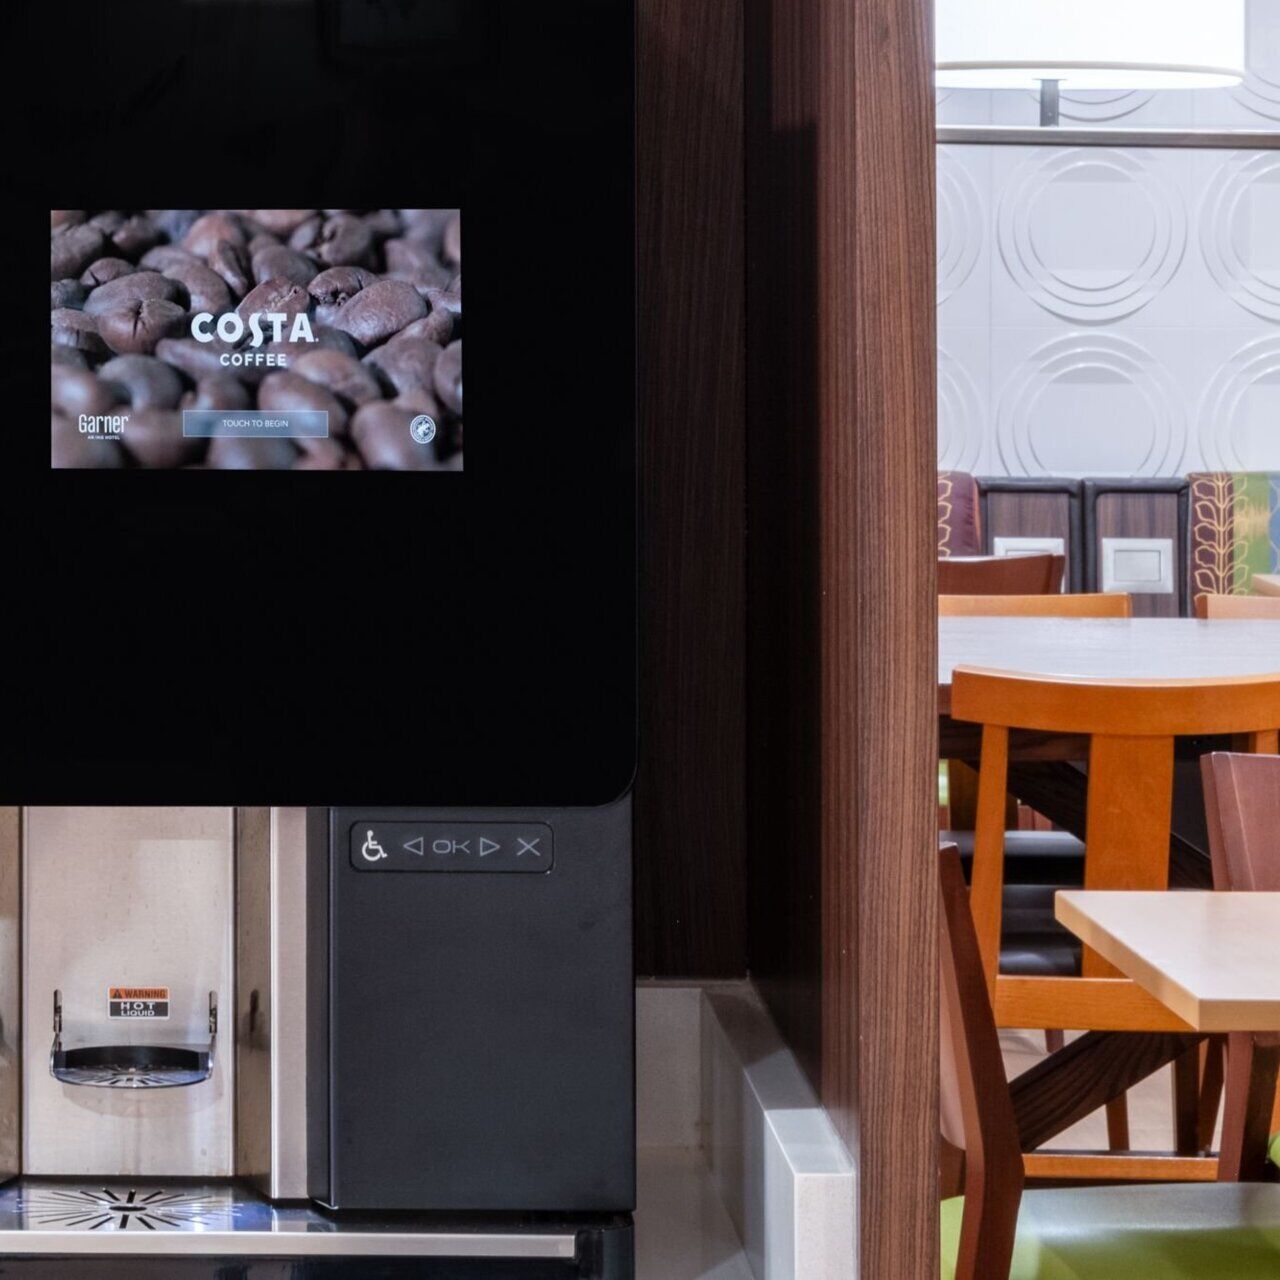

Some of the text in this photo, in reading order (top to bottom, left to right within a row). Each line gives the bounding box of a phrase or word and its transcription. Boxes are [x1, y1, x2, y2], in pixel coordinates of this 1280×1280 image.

[190, 312, 315, 348] COSTA
[220, 353, 288, 367] COFFEE
[78, 413, 129, 434] Garner
[222, 419, 289, 429] TOUCH TO BEGIN
[432, 839, 471, 854] OK
[126, 988, 166, 999] WARNING
[120, 1001, 156, 1010] HOT
